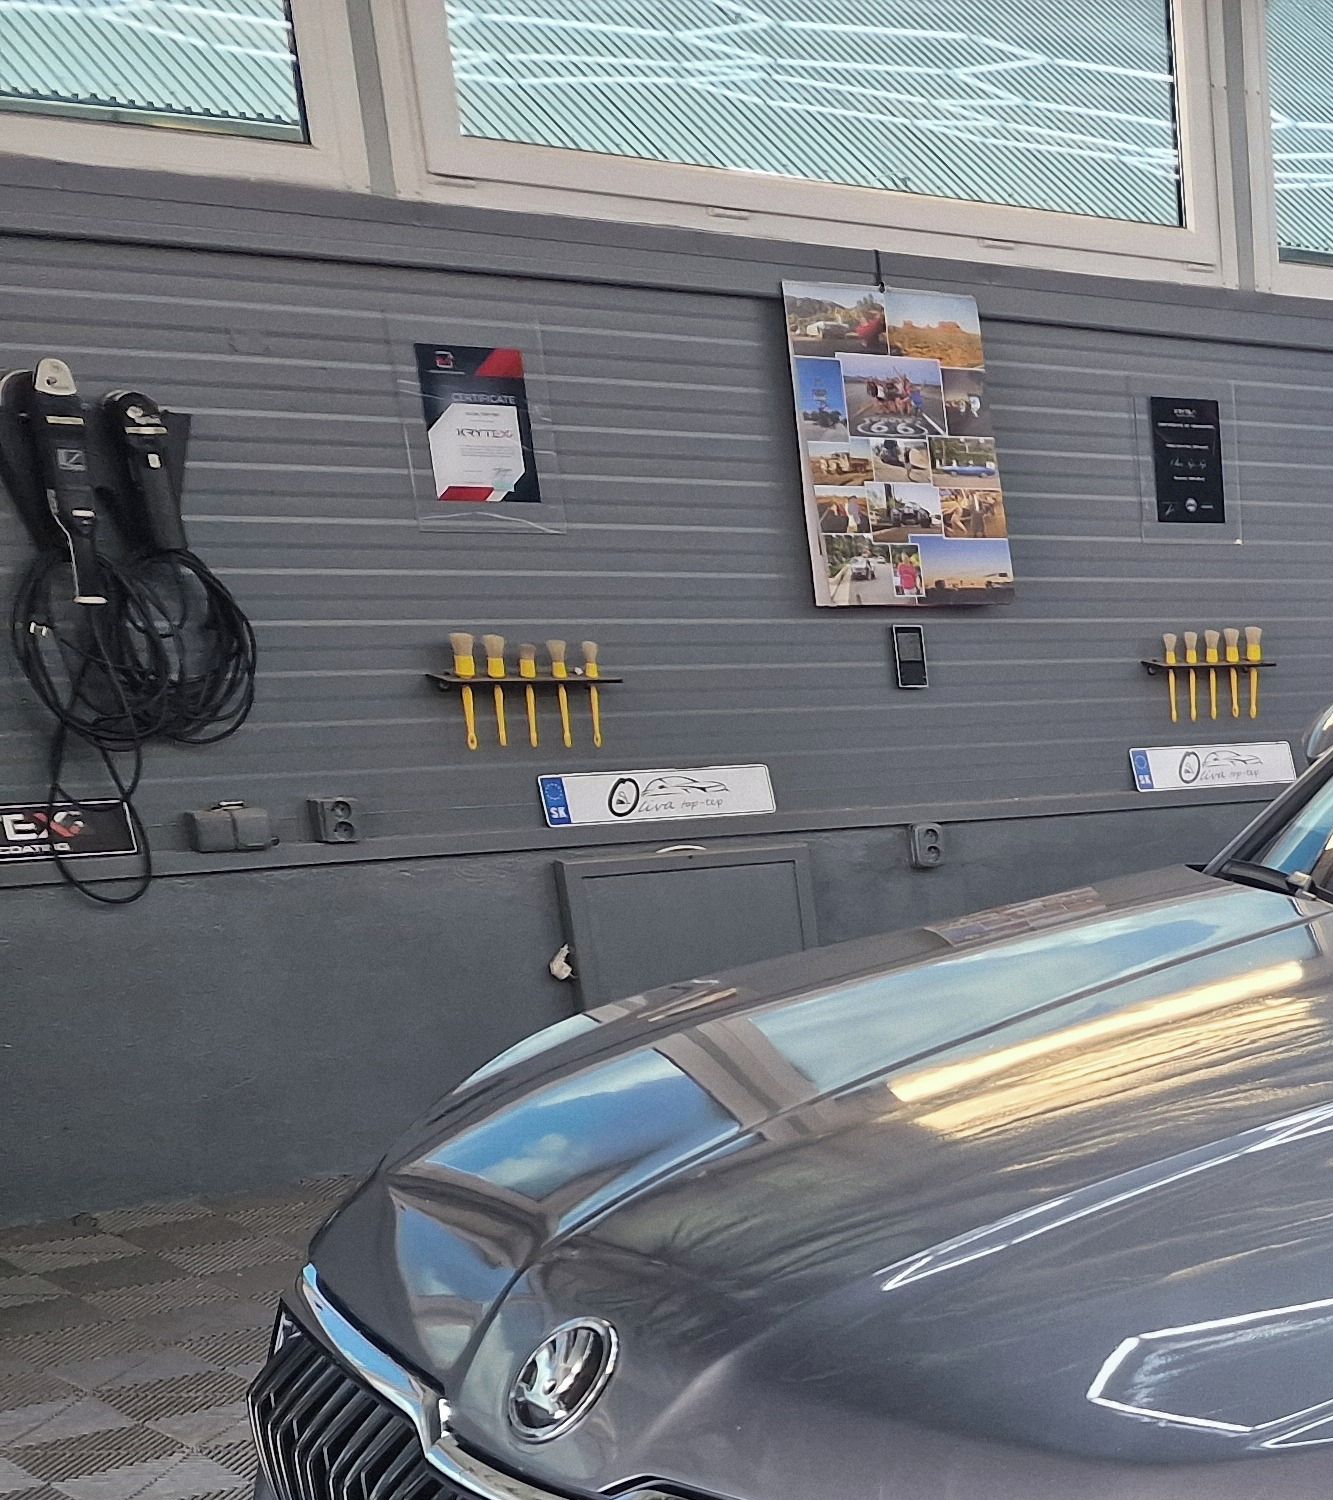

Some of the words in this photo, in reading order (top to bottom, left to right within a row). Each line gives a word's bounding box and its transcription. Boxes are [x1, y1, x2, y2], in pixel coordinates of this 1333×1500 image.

[451, 392, 516, 404] CERTIFICATE
[608, 777, 675, 817] Oliva
[550, 806, 567, 819] SK
